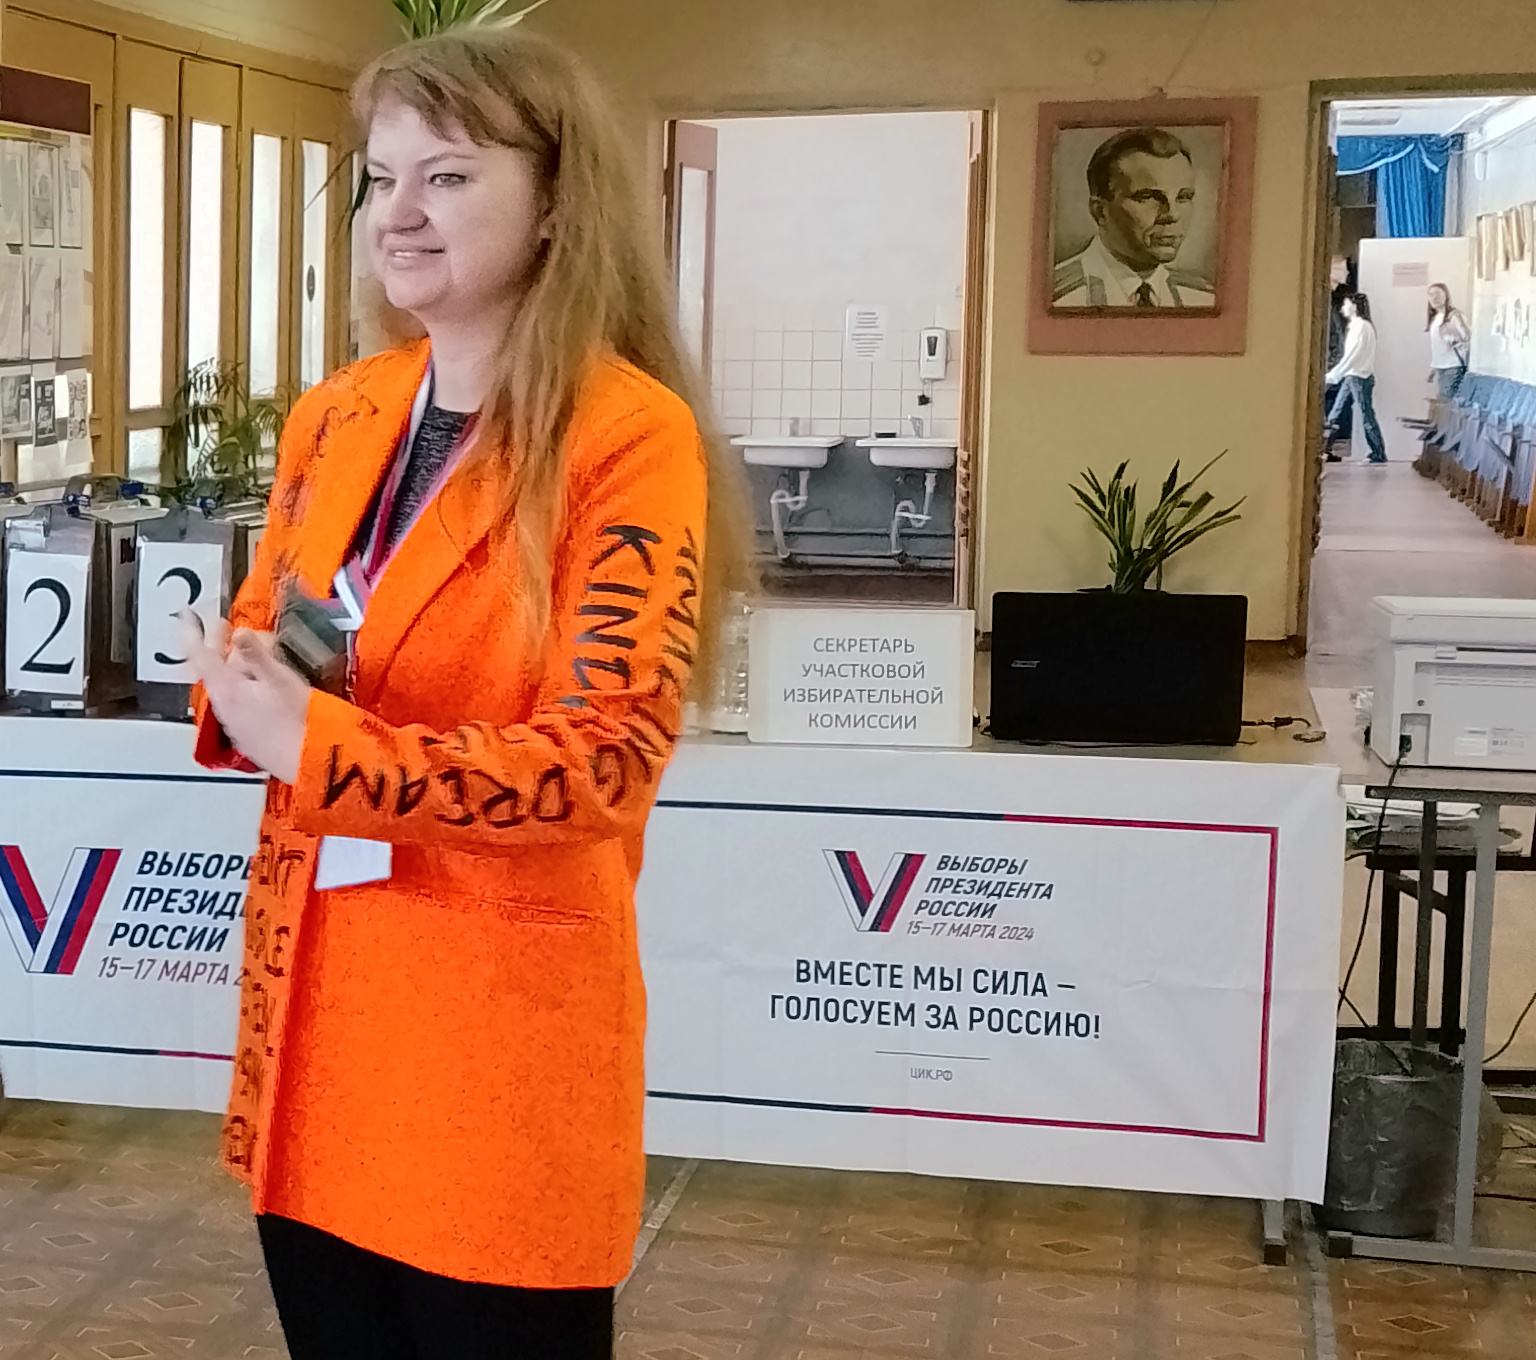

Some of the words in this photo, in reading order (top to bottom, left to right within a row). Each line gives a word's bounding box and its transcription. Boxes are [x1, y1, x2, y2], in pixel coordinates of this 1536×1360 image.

[19, 577, 76, 675] 2
[153, 566, 205, 665] 3
[813, 637, 915, 654] СЕКРЕТАРЬ
[801, 660, 926, 679] УЧАСТКОВОЙ
[783, 687, 944, 705] ИЗБИРАТЕЛЬНОЙ
[808, 713, 917, 730] КОМИССИИ
[936, 854, 1028, 876] ВЫБОРЫ
[924, 877, 1055, 900] ПРЕЗИДЕНТА
[122, 886, 247, 921] ПРЕЗИД
[914, 900, 998, 920] РОССИИ
[108, 923, 230, 953] РОССИИ
[948, 922, 997, 939] МАРТА
[999, 925, 1035, 941] 2024
[157, 959, 231, 986] МАРТА
[796, 959, 904, 989] ВМЕСТЕ
[913, 965, 962, 993] МЫ
[972, 968, 1049, 997] СИЛА
[770, 994, 916, 1028] ГОЛОСУЕМ
[924, 1003, 960, 1031] ЗА
[968, 1006, 1100, 1039] РОССИЮ!
[910, 1067, 953, 1082] ЦИК.РФ
